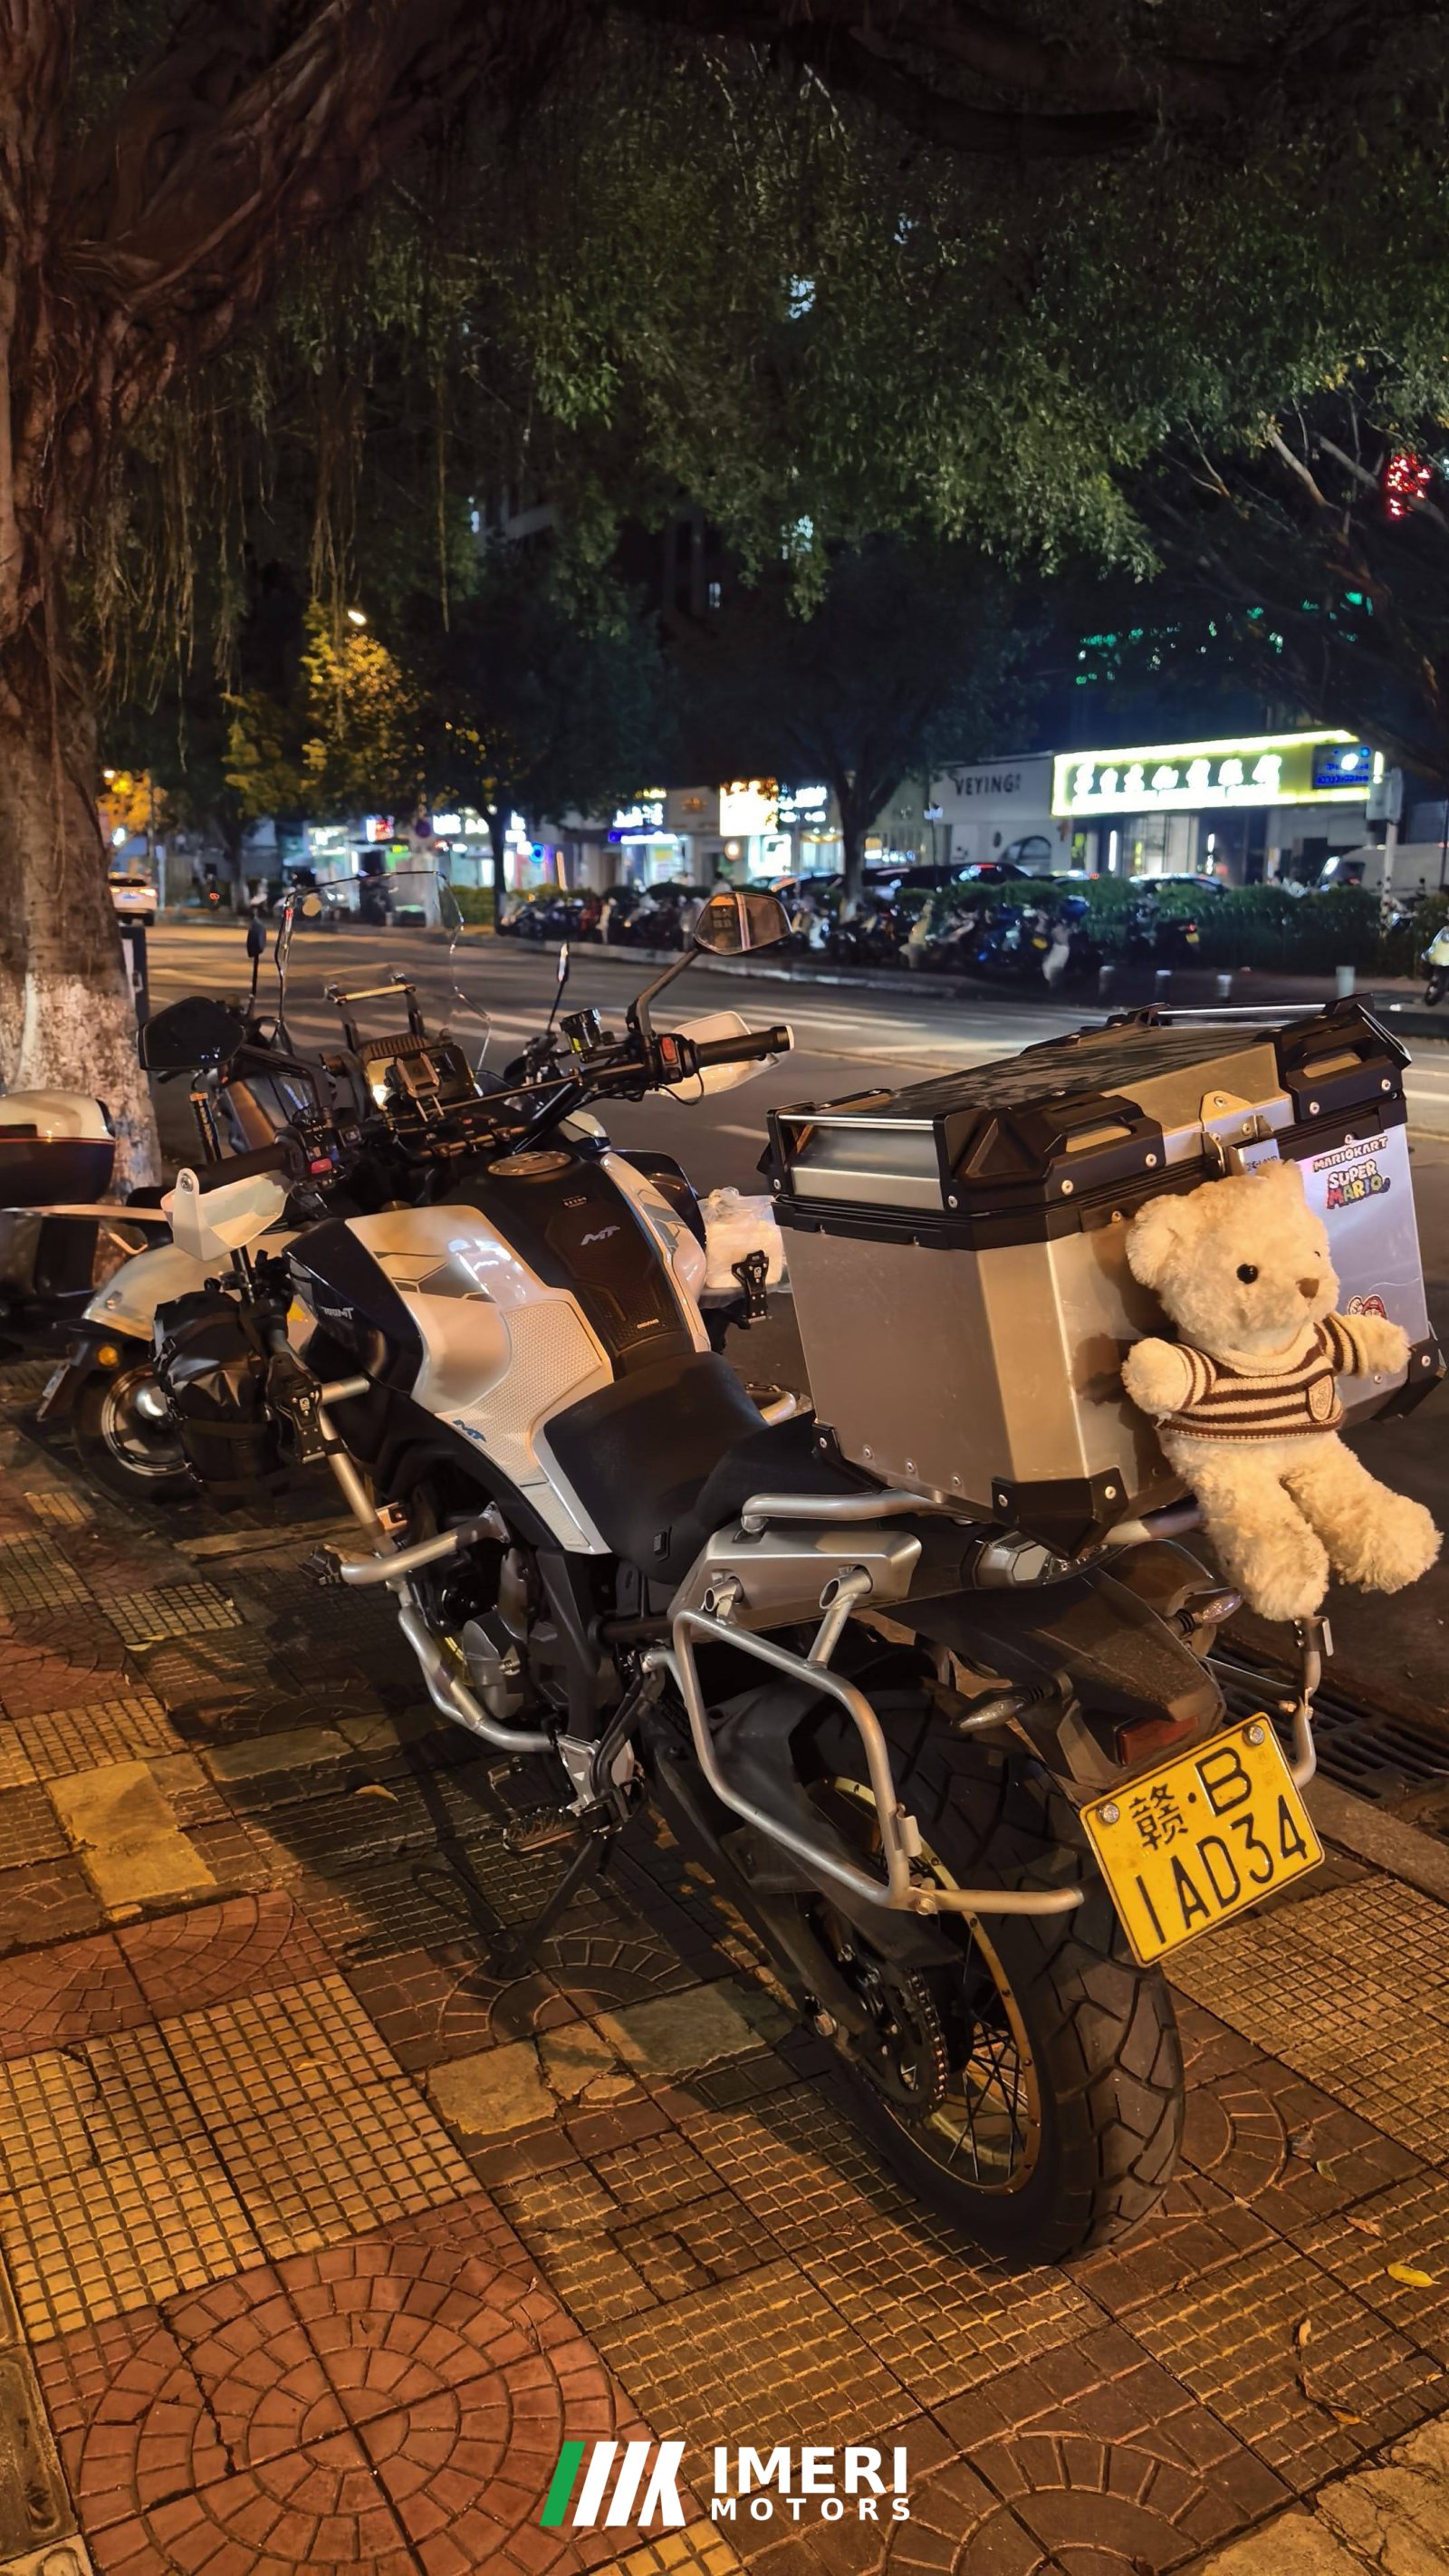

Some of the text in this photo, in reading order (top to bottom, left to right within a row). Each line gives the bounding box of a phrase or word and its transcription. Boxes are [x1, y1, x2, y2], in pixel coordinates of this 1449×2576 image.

[1328, 1158, 1377, 1189] SUPER
[1327, 1175, 1384, 1209] MARIO
[1135, 1794, 1308, 1945] 1AD34
